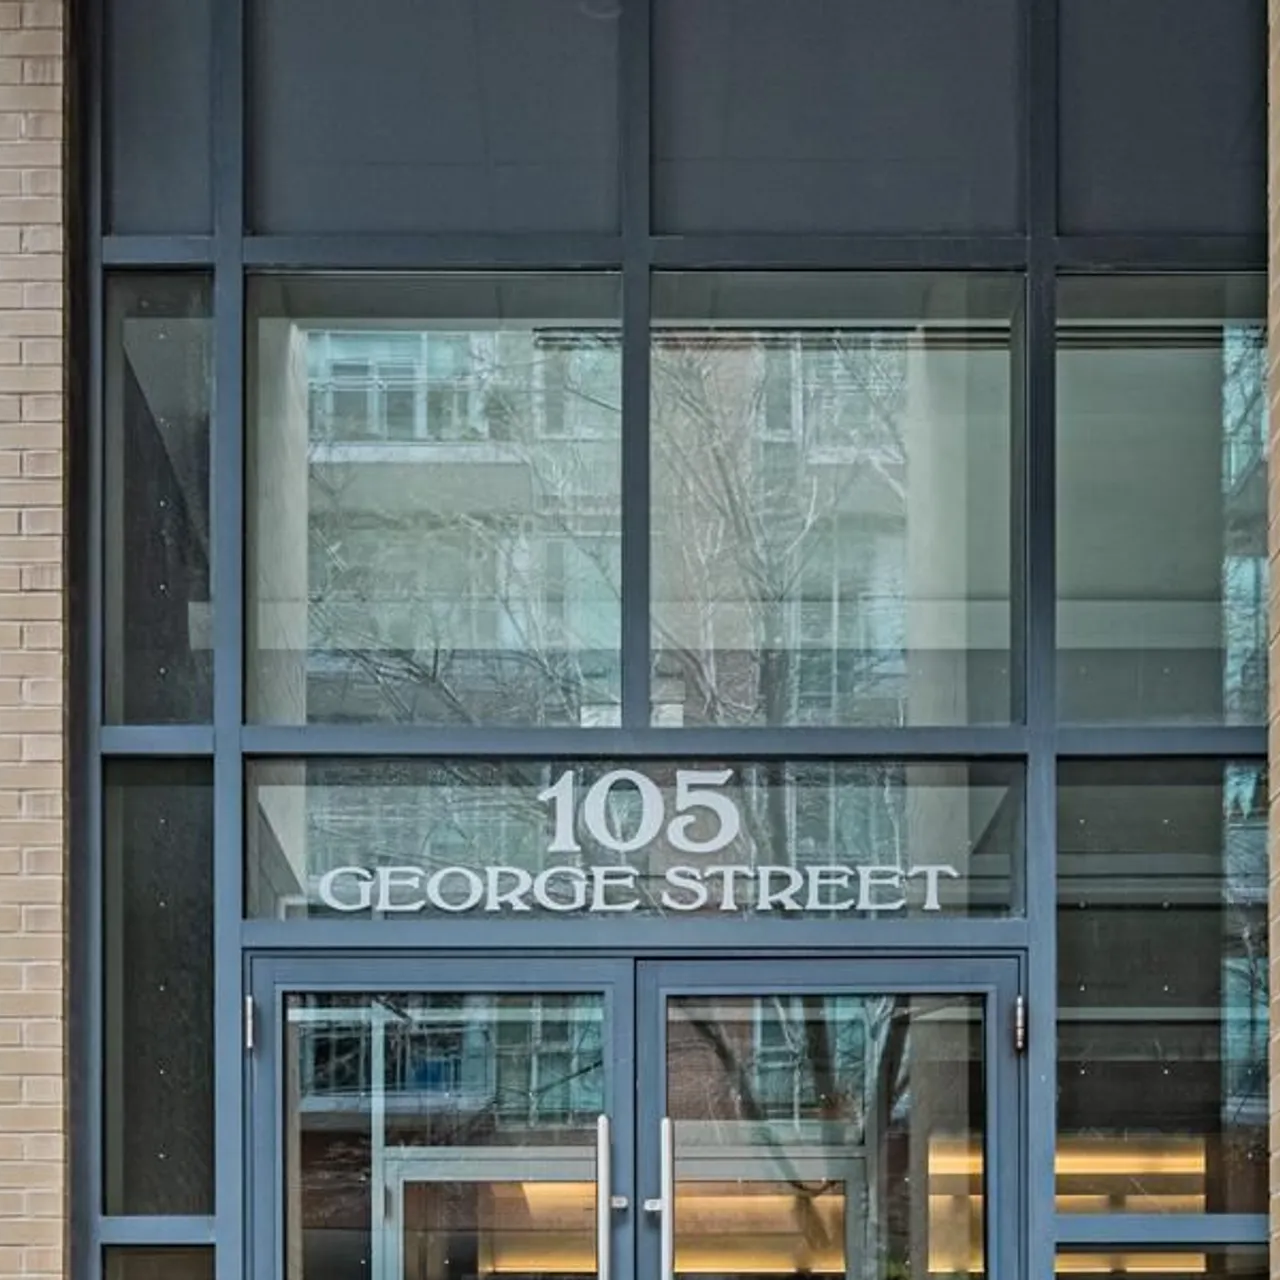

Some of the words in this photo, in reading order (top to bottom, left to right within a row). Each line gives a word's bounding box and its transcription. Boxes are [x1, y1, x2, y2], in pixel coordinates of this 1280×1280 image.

[538, 766, 742, 856] 105
[318, 865, 642, 913] GEORGE
[661, 864, 960, 912] STREET
